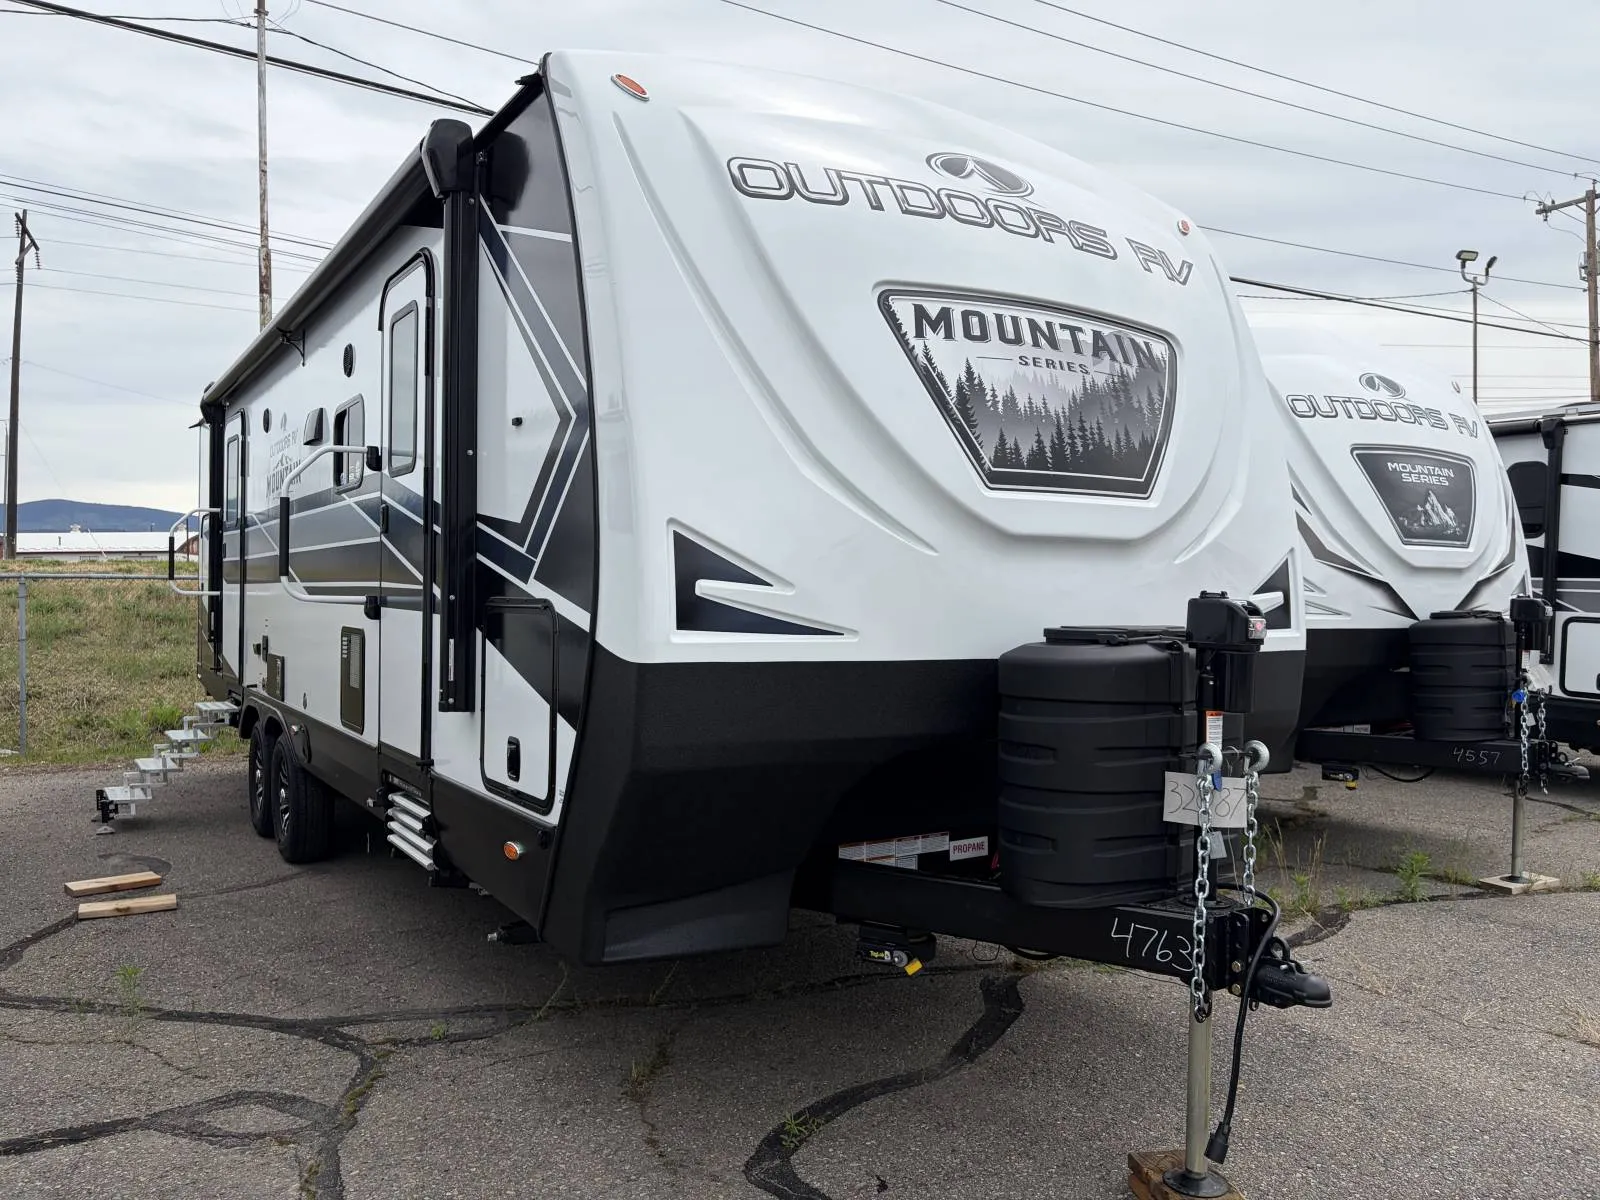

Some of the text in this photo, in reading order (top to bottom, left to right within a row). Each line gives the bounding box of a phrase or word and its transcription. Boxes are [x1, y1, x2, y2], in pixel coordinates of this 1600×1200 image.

[727, 156, 1194, 286] OUTDOORS RV
[911, 303, 1163, 374] MOUNTAIN
[1018, 354, 1091, 376] SERIES
[1286, 394, 1479, 439] OUTDOORS RV
[1387, 461, 1455, 478] MOUNTAIN
[1401, 472, 1449, 486] SERIES
[1452, 746, 1500, 767] 4557
[952, 841, 985, 855] PROPANE
[1111, 916, 1195, 972] 4763
